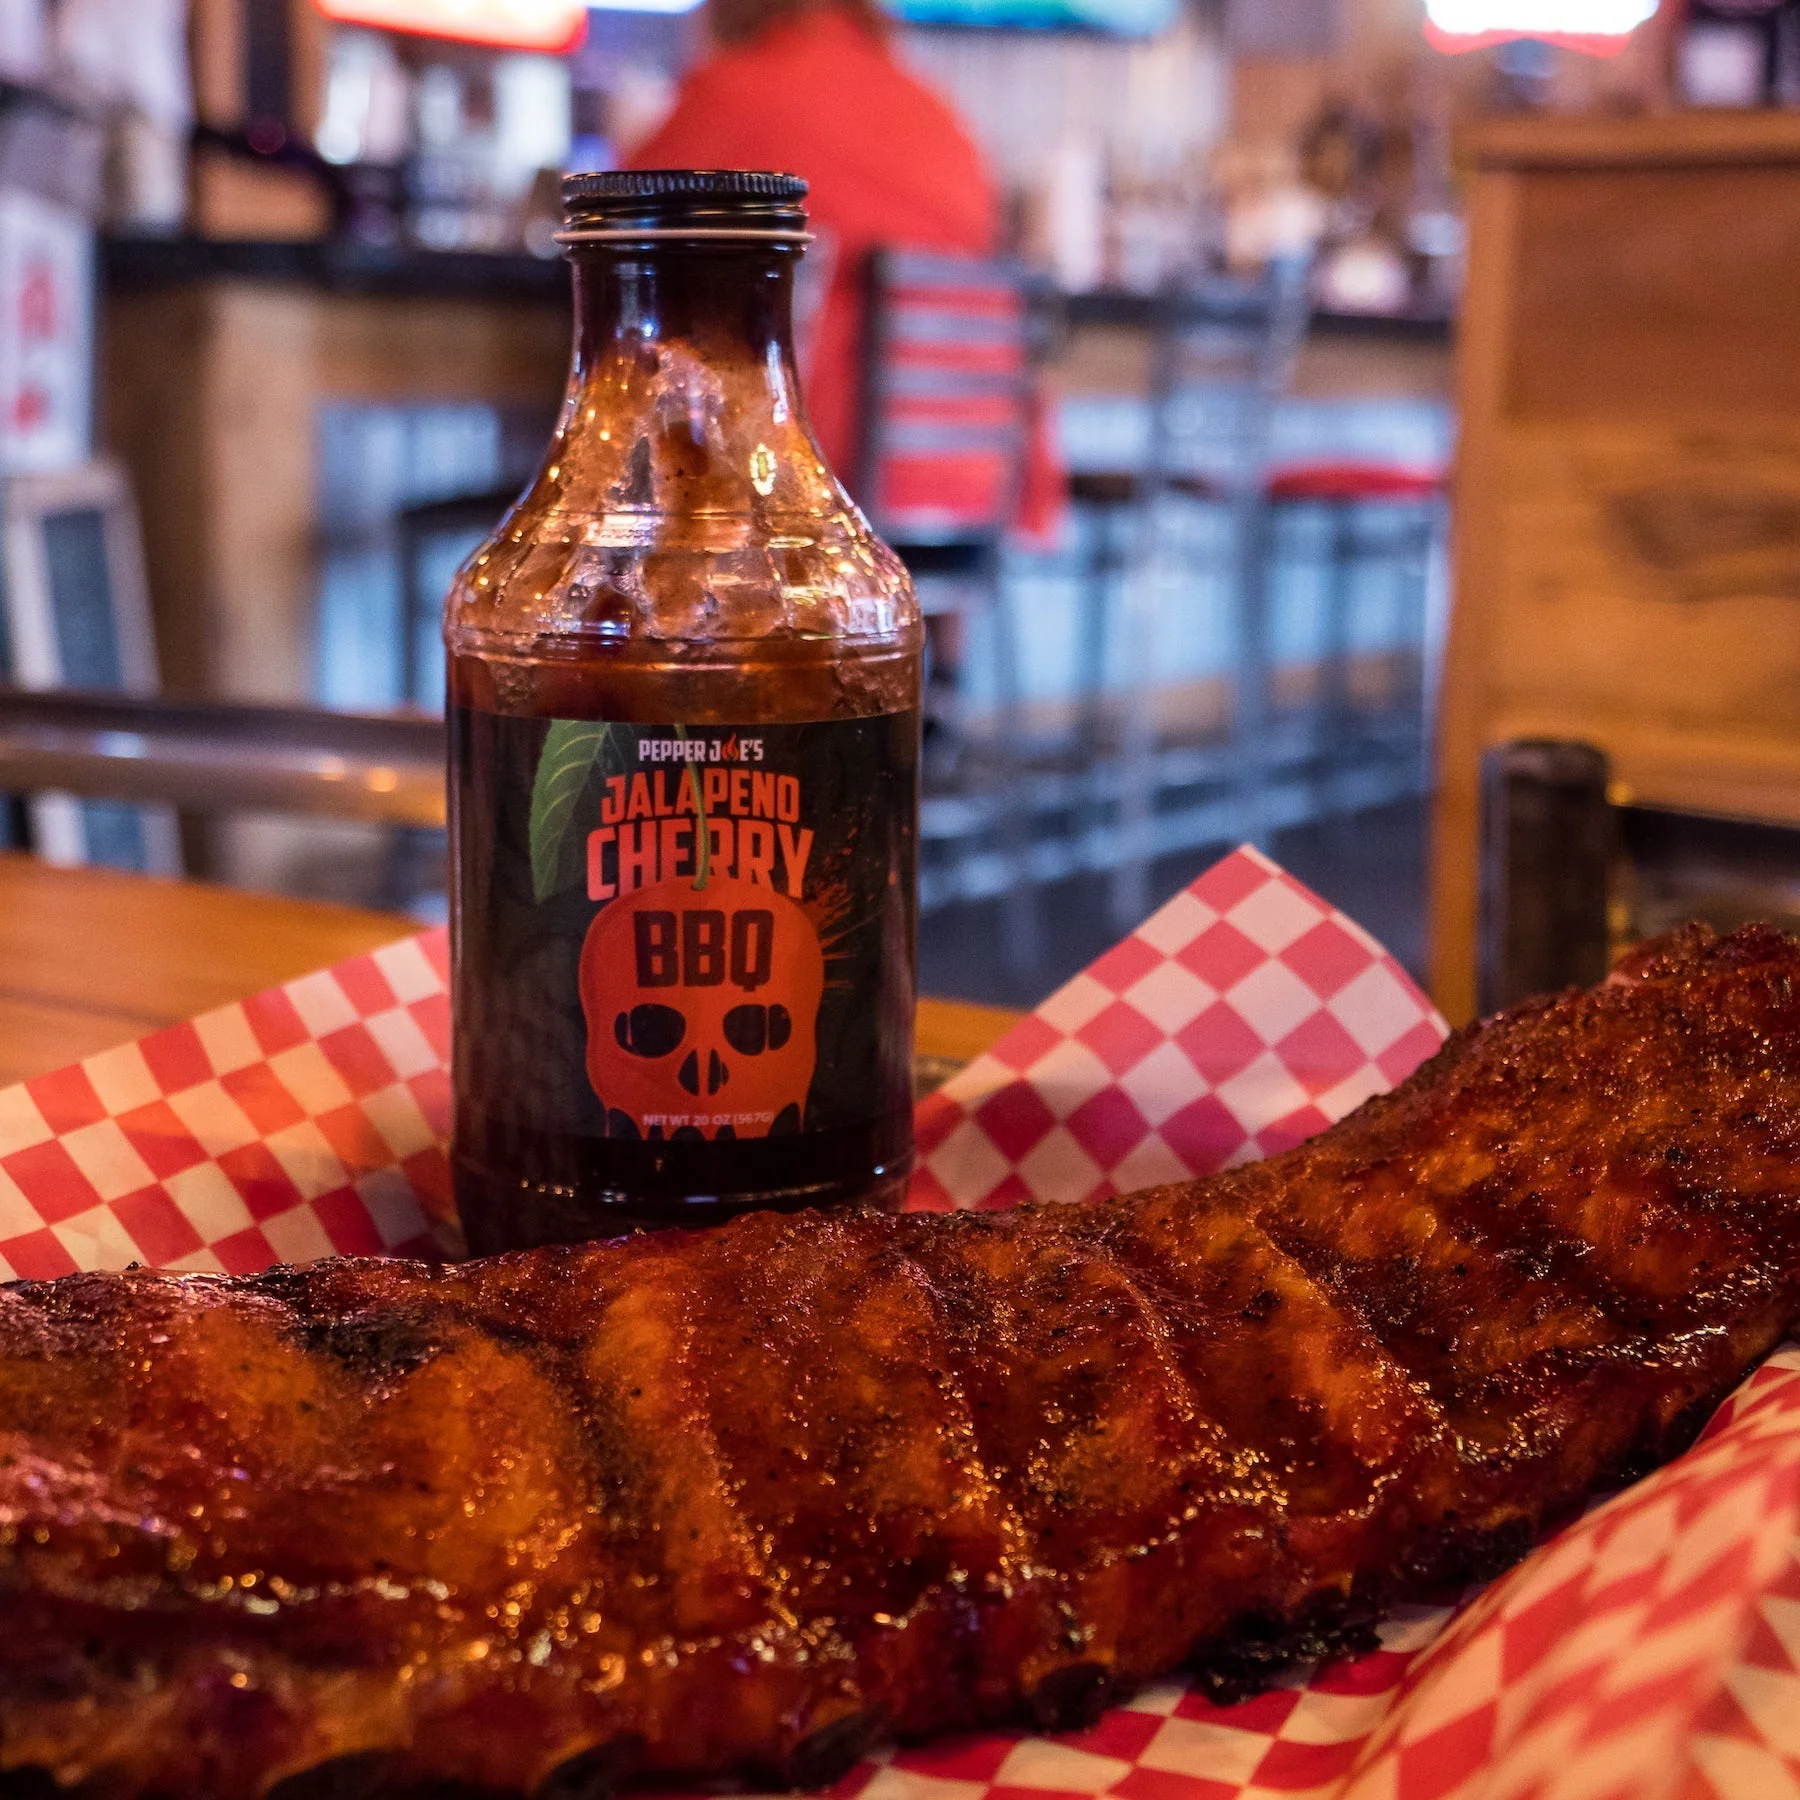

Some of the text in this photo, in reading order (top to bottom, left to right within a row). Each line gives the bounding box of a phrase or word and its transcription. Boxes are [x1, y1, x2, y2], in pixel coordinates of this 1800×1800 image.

[639, 739, 706, 762] PEPPER
[601, 767, 800, 825] JALAPENO
[586, 817, 815, 902] CHERRY
[633, 909, 774, 993] BBQ
[642, 1113, 668, 1126] NET
[669, 1114, 690, 1127] WT
[692, 1114, 710, 1127] 20
[711, 1113, 731, 1126] OZ
